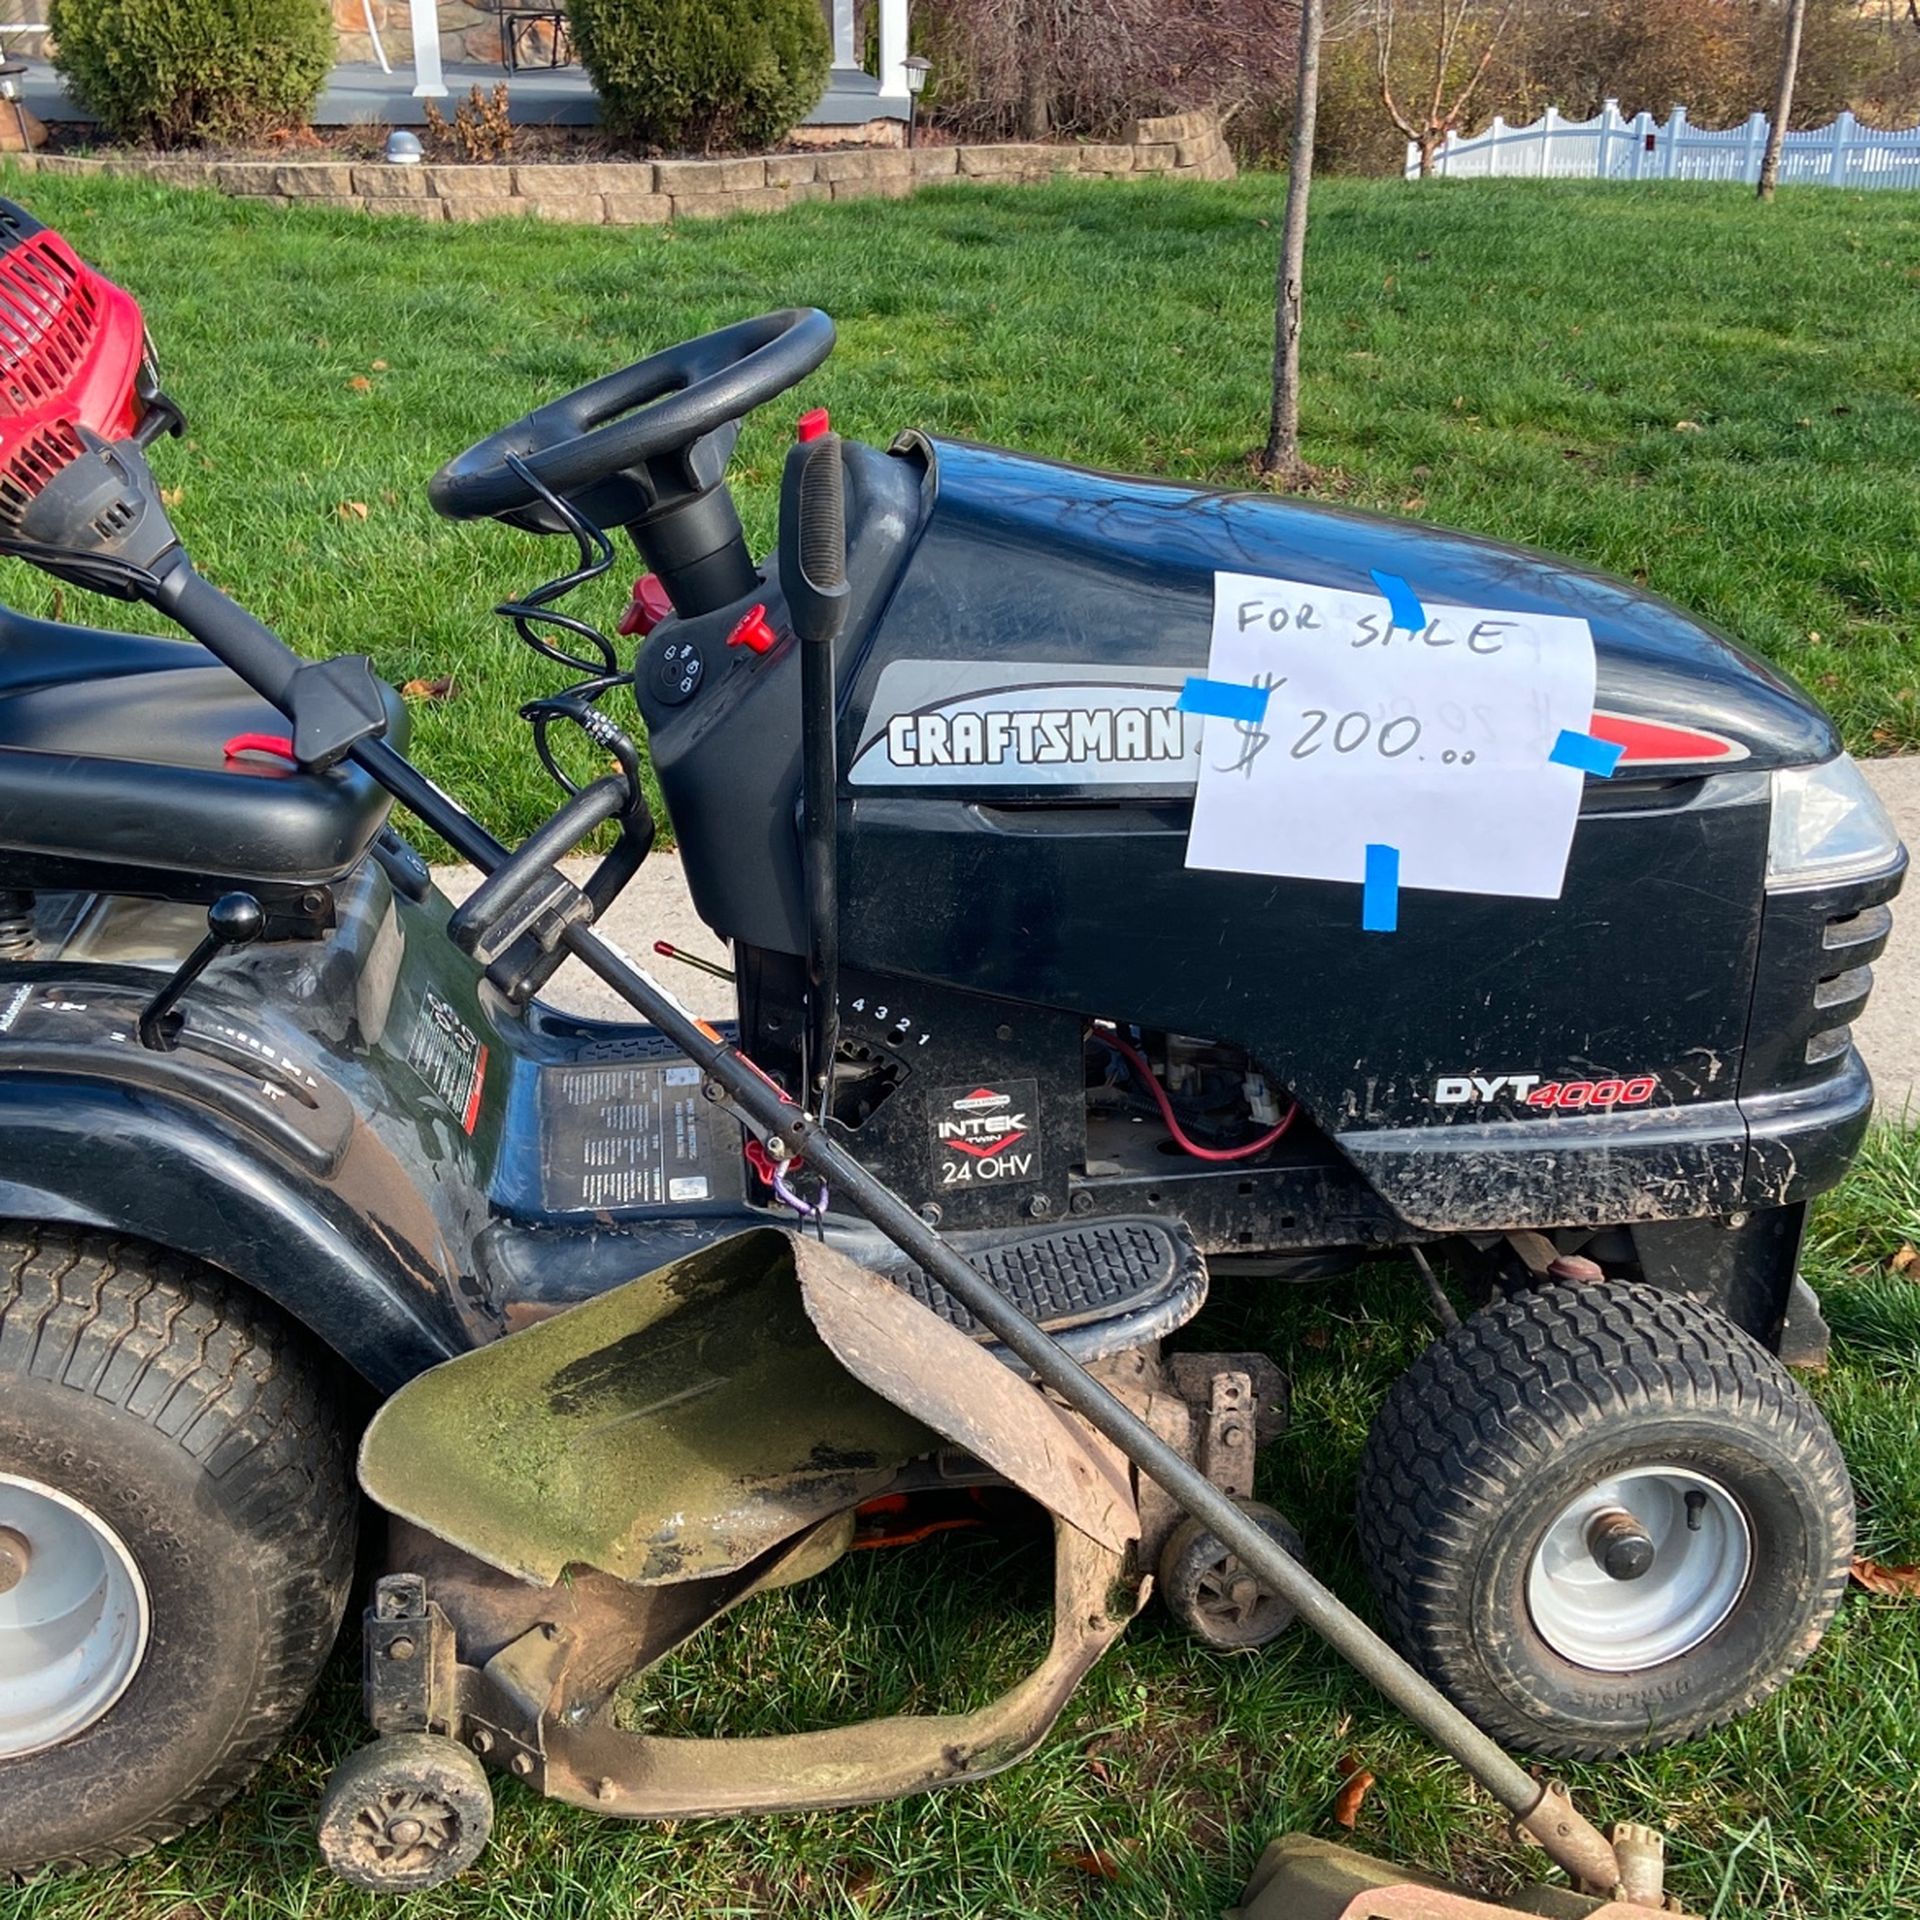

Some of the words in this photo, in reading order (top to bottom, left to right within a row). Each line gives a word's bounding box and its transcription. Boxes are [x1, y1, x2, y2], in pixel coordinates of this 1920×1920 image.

[1238, 600, 1322, 633] FOR
[886, 707, 1185, 767] CRAFTSMAN
[851, 997, 866, 1012] 4
[874, 1005, 889, 1020] 3
[895, 1017, 912, 1033] 2
[918, 1033, 931, 1046] 1
[938, 1113, 1028, 1139] INTEK
[964, 1133, 1003, 1145] TWIN
[941, 1160, 973, 1184] 24
[976, 1153, 1033, 1180] OHV
